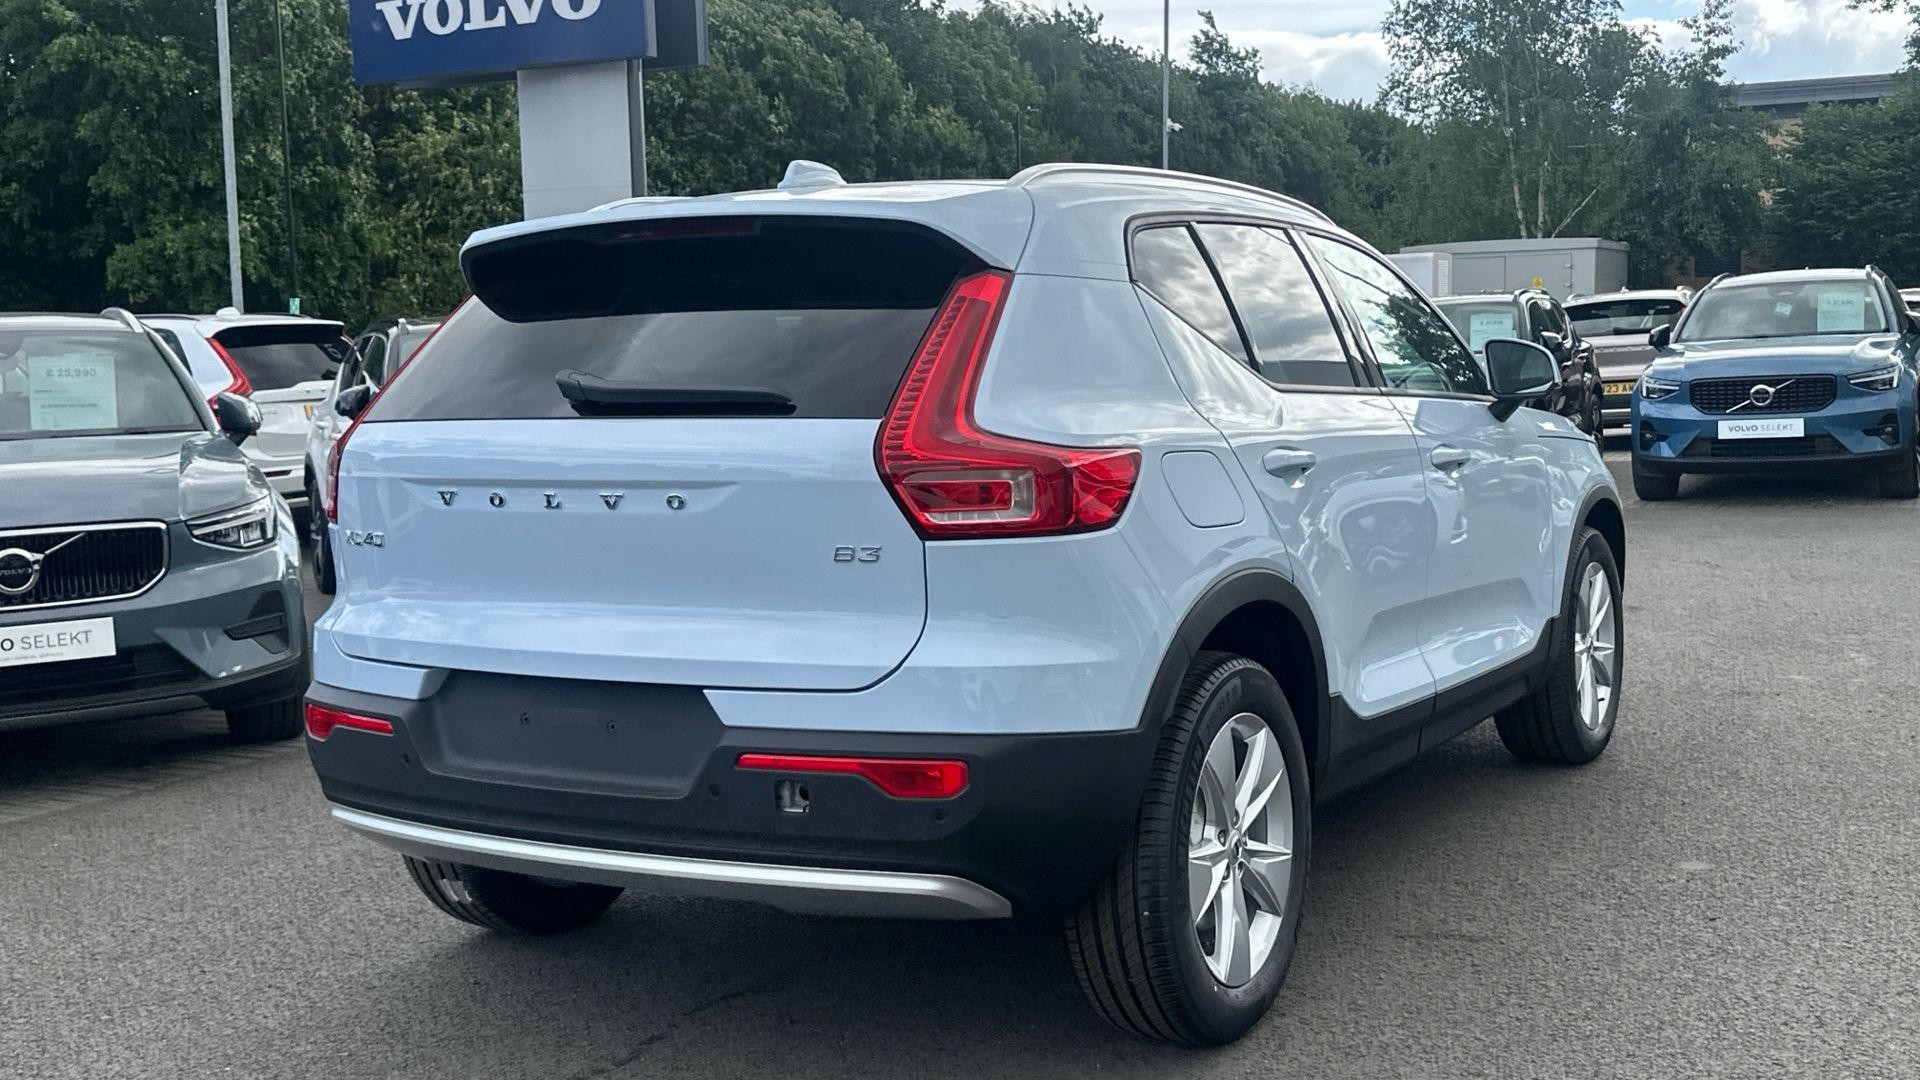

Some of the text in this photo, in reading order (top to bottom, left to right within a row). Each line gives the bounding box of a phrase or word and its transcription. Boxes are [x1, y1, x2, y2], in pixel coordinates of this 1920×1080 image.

[375, 0, 602, 40] VOLVO
[1728, 423, 1795, 432] VOLVO SELEKT
[437, 489, 690, 511] VOLVO
[345, 529, 386, 547] XC40
[833, 545, 882, 563] B3
[20, 629, 92, 650] SELEKT
